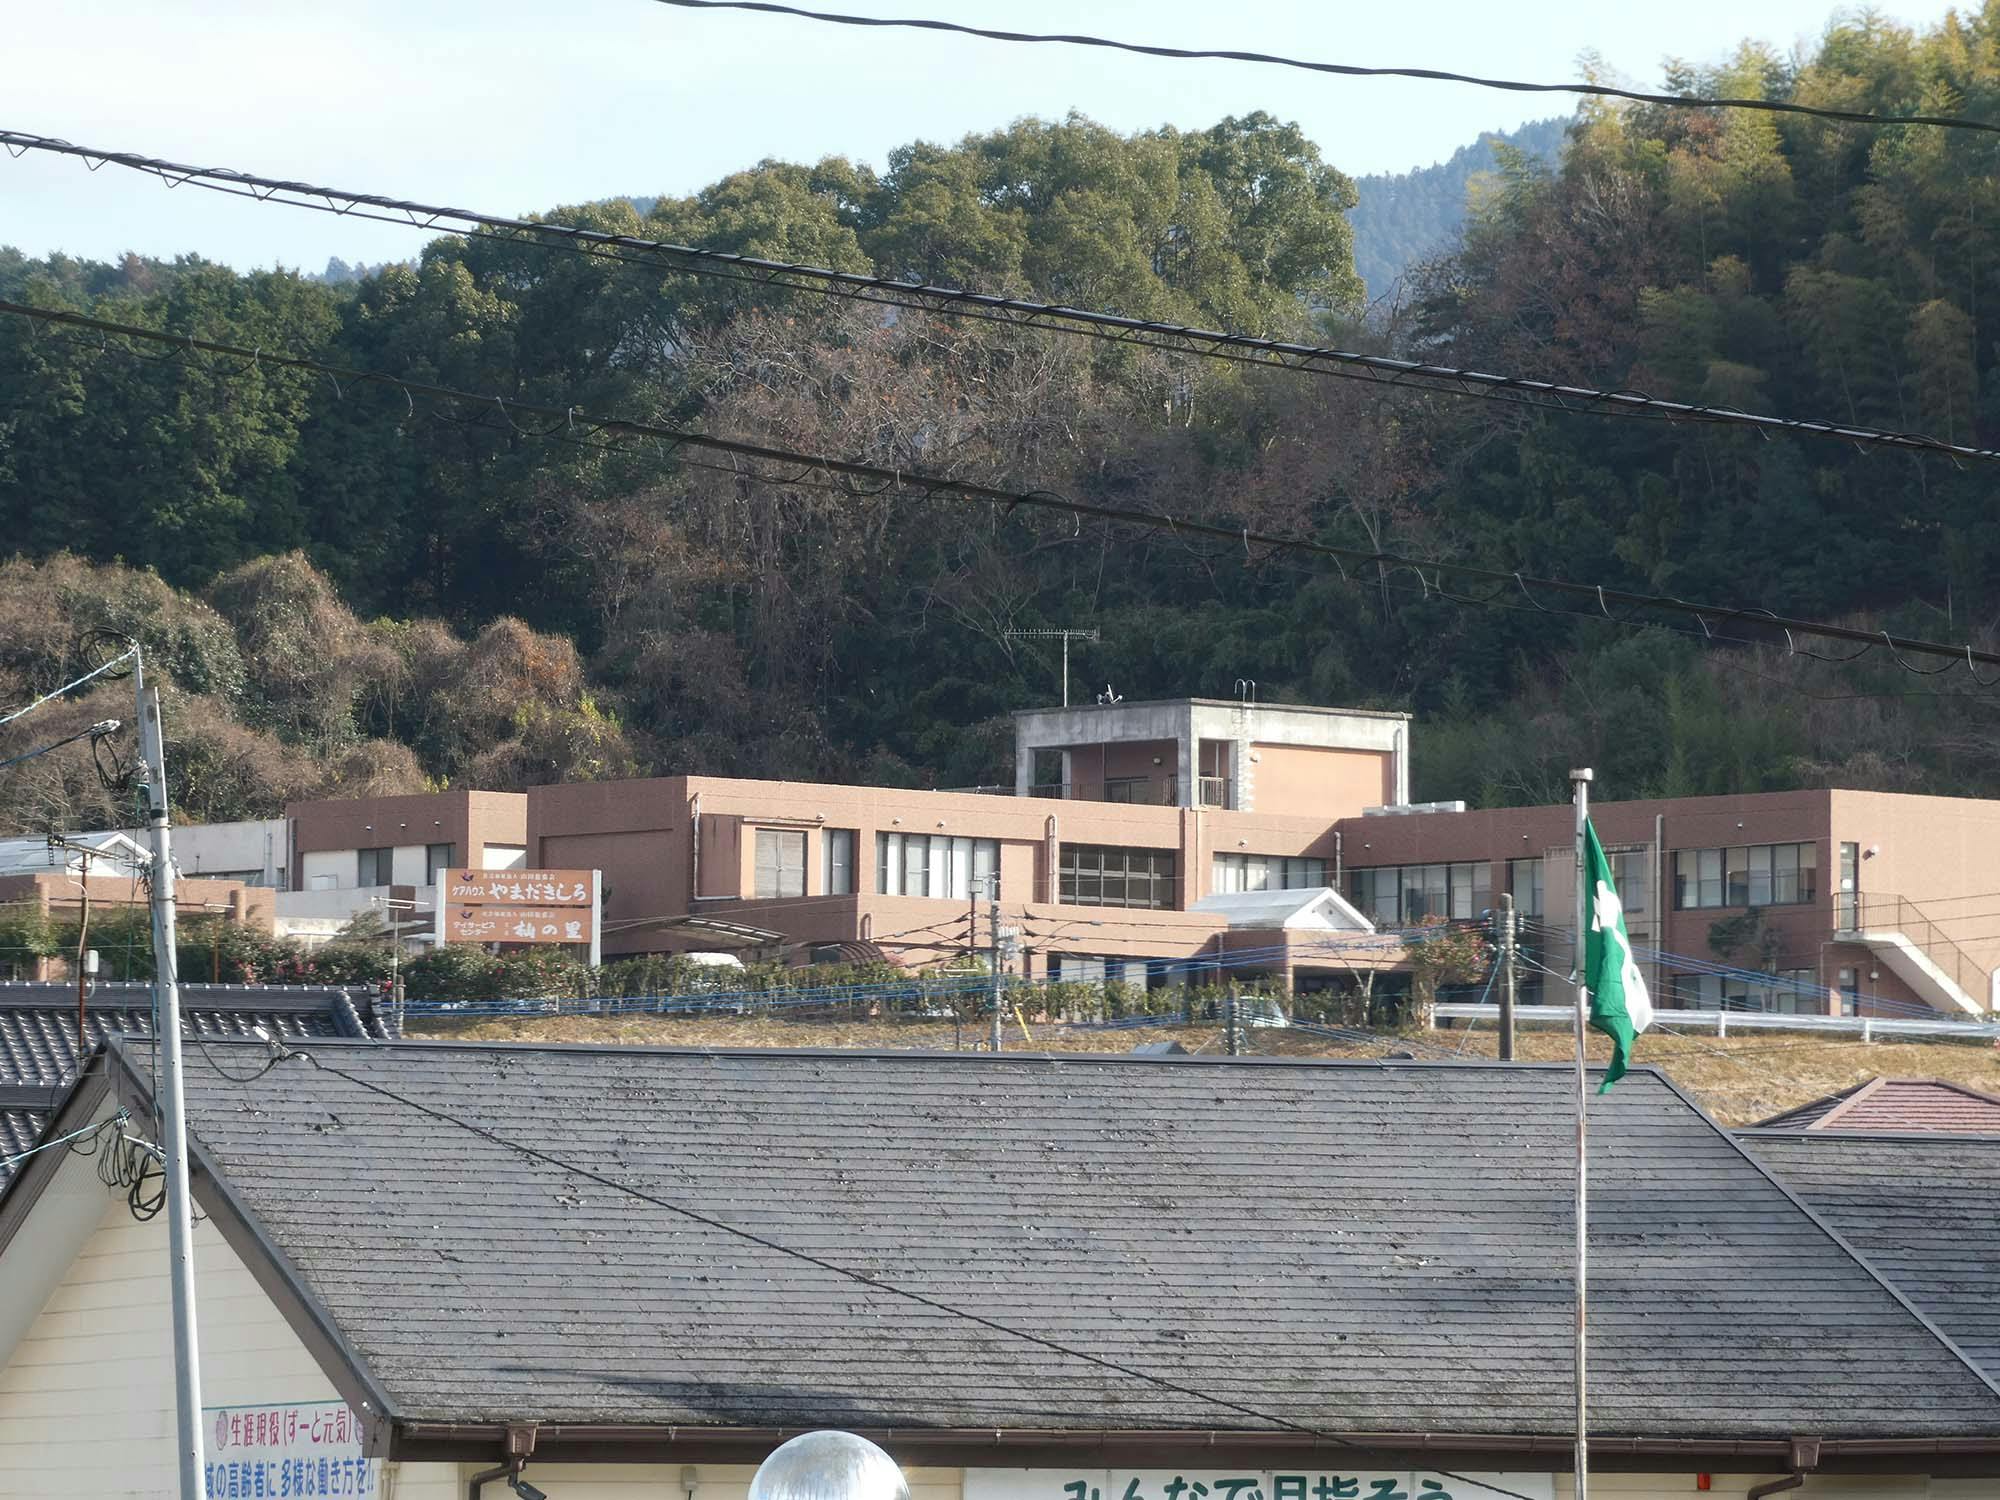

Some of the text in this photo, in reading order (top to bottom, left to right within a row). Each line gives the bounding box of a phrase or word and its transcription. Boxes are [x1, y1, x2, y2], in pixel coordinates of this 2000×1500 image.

[452, 882, 587, 901] ケアハウス やまだきしろ
